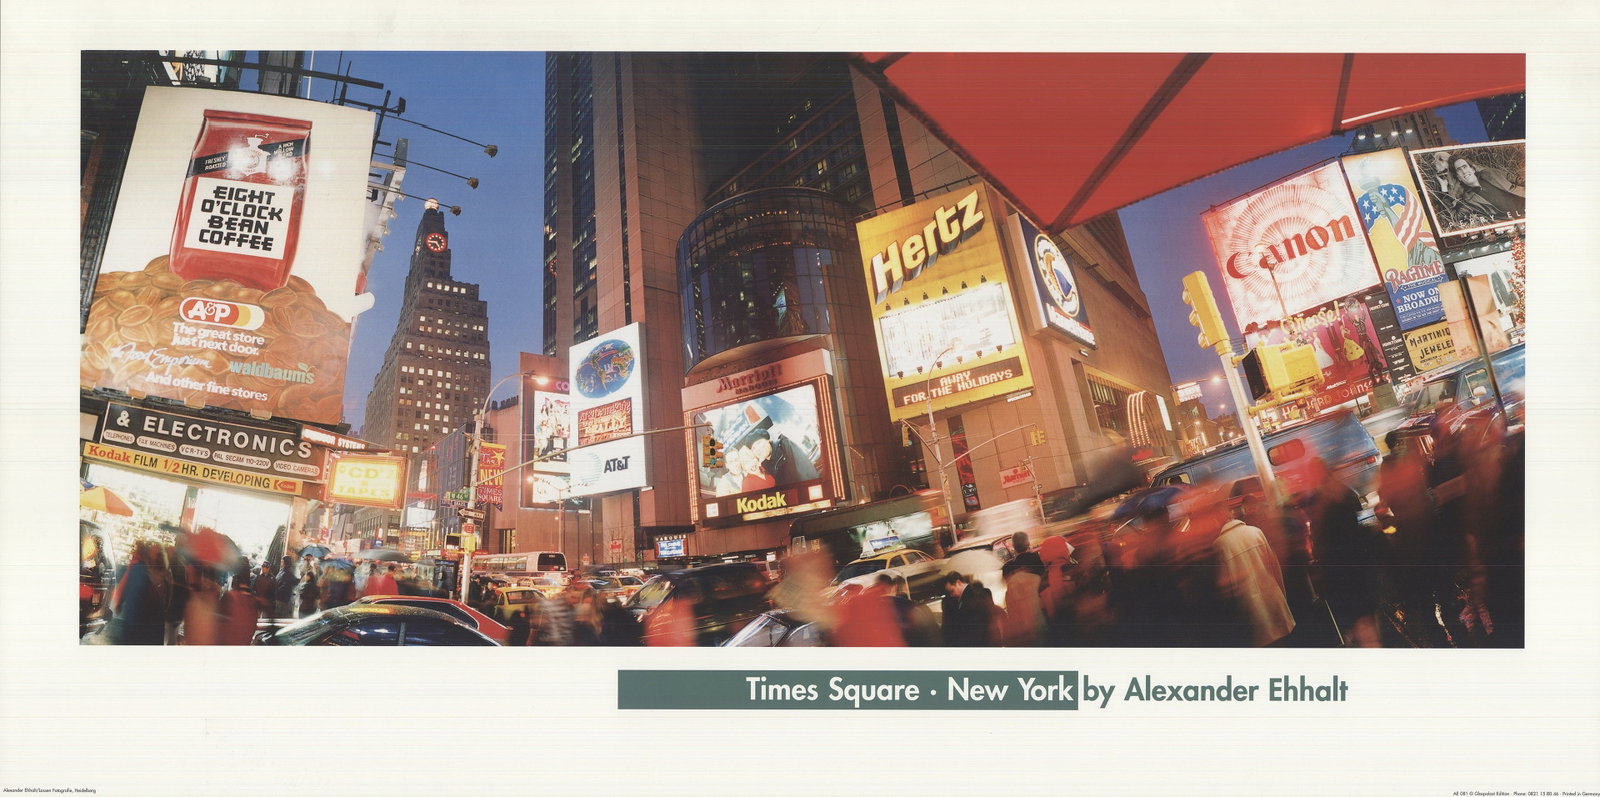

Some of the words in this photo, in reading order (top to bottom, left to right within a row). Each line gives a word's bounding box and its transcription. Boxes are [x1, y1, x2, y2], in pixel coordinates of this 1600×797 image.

[212, 185, 276, 205] EIGHT
[200, 199, 284, 222] O'CLOCK
[207, 215, 270, 235] BEAN
[198, 228, 274, 251] COFFEE
[871, 190, 985, 300] Hertz
[1226, 214, 1356, 279] Canon
[1384, 259, 1446, 294] RAGTIME
[1396, 296, 1442, 313] BROADW
[1402, 291, 1426, 304] NOW
[187, 300, 231, 322] A&P
[173, 322, 196, 335] The
[197, 327, 231, 342] great
[232, 331, 265, 345] store
[171, 334, 198, 348] just
[198, 338, 227, 351] next
[229, 342, 259, 356] door.
[1420, 339, 1455, 360] JEWELE
[145, 372, 172, 386] And
[173, 376, 205, 391] other
[206, 381, 230, 396] fine
[231, 387, 268, 401] stores
[903, 391, 927, 405] FOR
[930, 385, 952, 399] THE
[957, 369, 1013, 392] HOLIDAYS
[940, 371, 971, 386] AWAY
[105, 431, 134, 443] TELEPHONES
[116, 410, 131, 428] &
[143, 415, 312, 459] ELECTRONICS
[138, 437, 149, 445] FAX
[149, 440, 175, 451] MACHINES
[181, 446, 209, 457] VCR-TVS
[214, 452, 224, 461] PAL
[225, 455, 245, 465] SECAM
[88, 445, 131, 464] Kodak
[133, 454, 158, 468] FILM
[162, 459, 180, 473] 1/2
[182, 464, 199, 477] HR.
[202, 467, 271, 489] DEVELOPING
[275, 462, 291, 471] VIDEO
[293, 465, 319, 475] CAMERAS
[603, 455, 631, 473] AT&T
[480, 469, 503, 486] NEW
[479, 486, 503, 497] TIMES
[736, 491, 788, 514] Kodak
